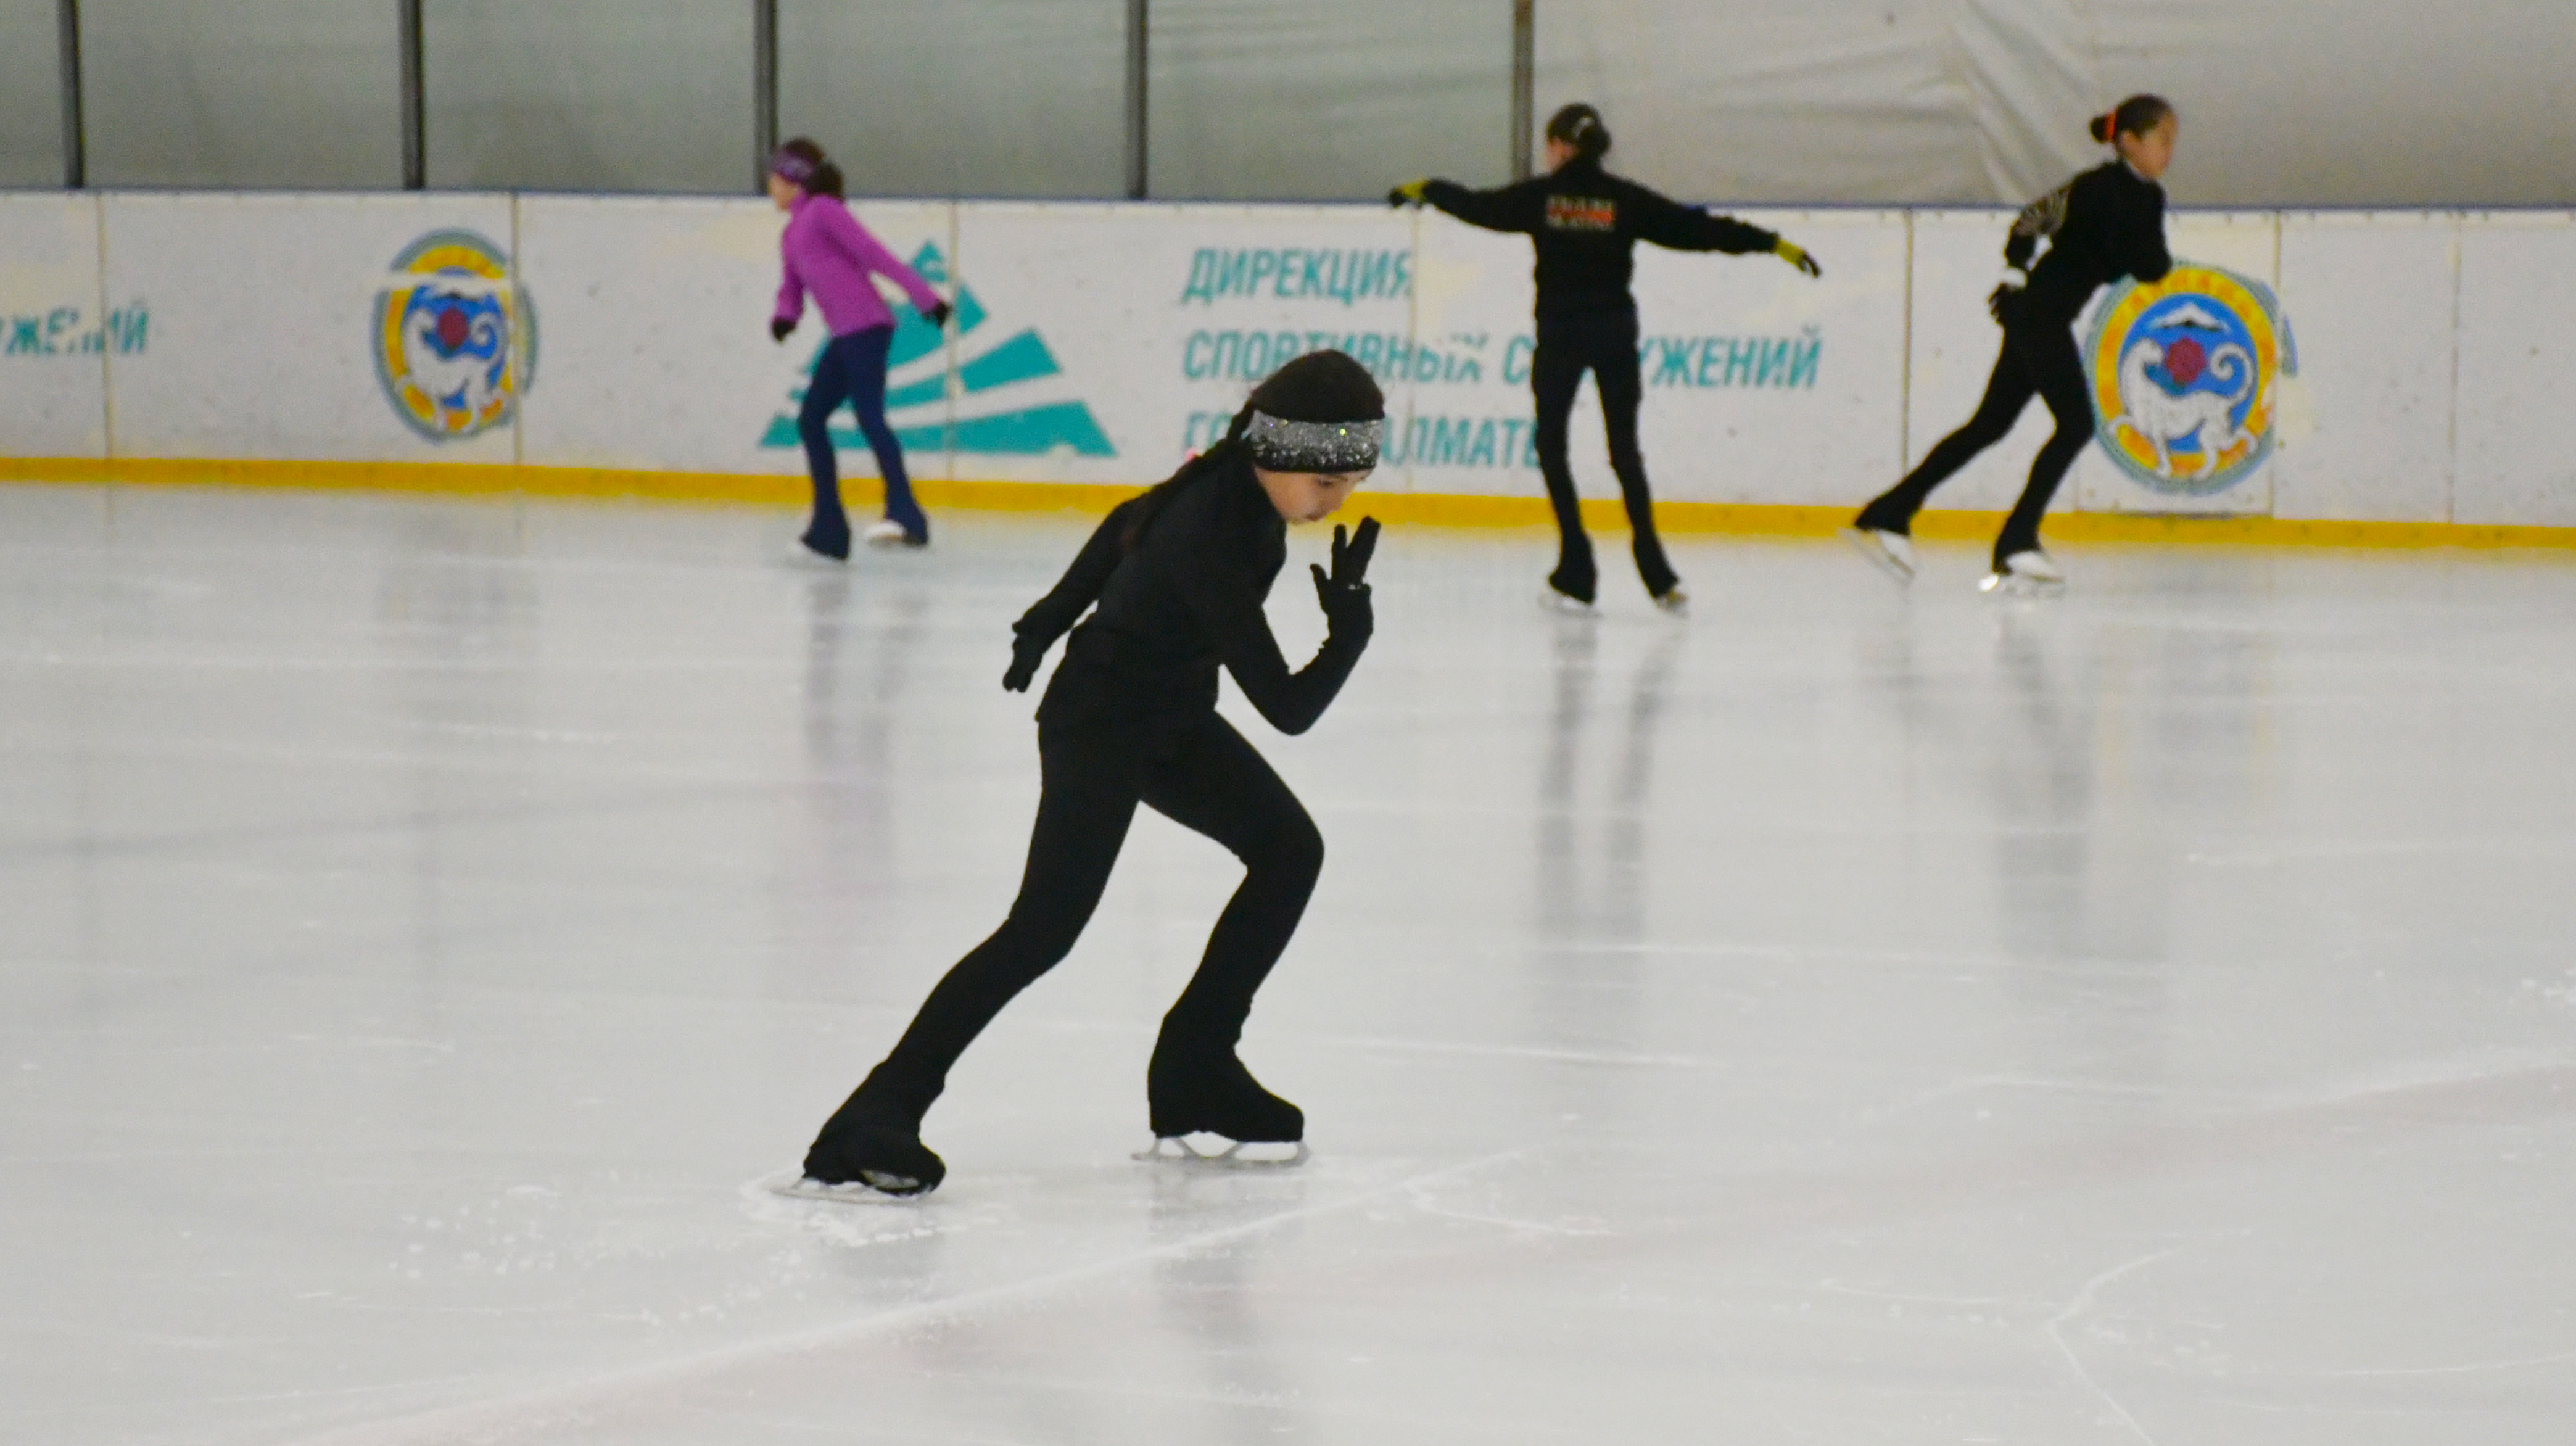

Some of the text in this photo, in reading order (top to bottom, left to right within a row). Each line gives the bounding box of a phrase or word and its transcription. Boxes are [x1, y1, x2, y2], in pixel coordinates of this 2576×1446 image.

[1181, 249, 1411, 306] ДИРЕКЦИЯ
[1503, 324, 1822, 388] СЖЕНИЙ
[1381, 416, 1538, 468] ЛМАТ
